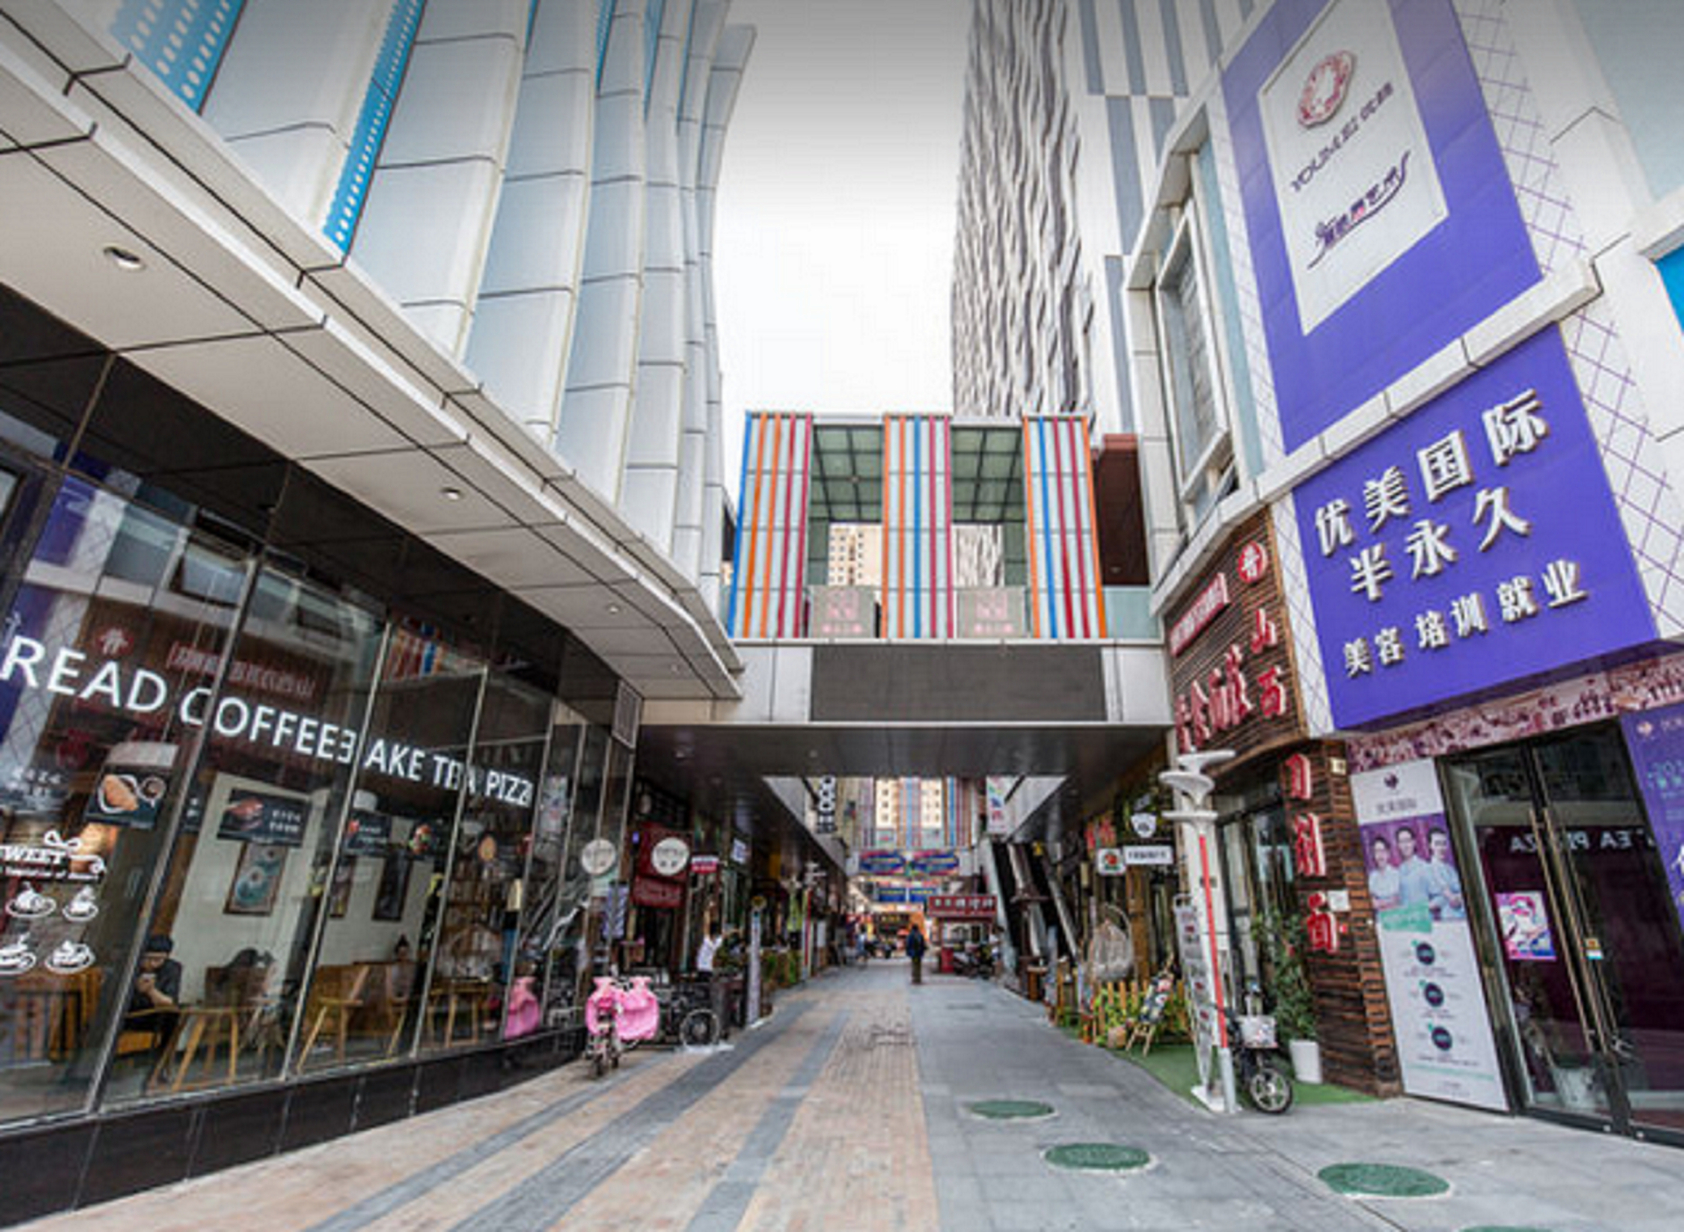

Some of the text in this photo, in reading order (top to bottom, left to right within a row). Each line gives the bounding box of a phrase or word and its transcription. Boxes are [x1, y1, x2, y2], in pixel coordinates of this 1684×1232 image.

[1315, 388, 1550, 556] 优美国际
[1350, 486, 1532, 601] 半永久
[1343, 558, 1589, 678] 美容 培训 就业
